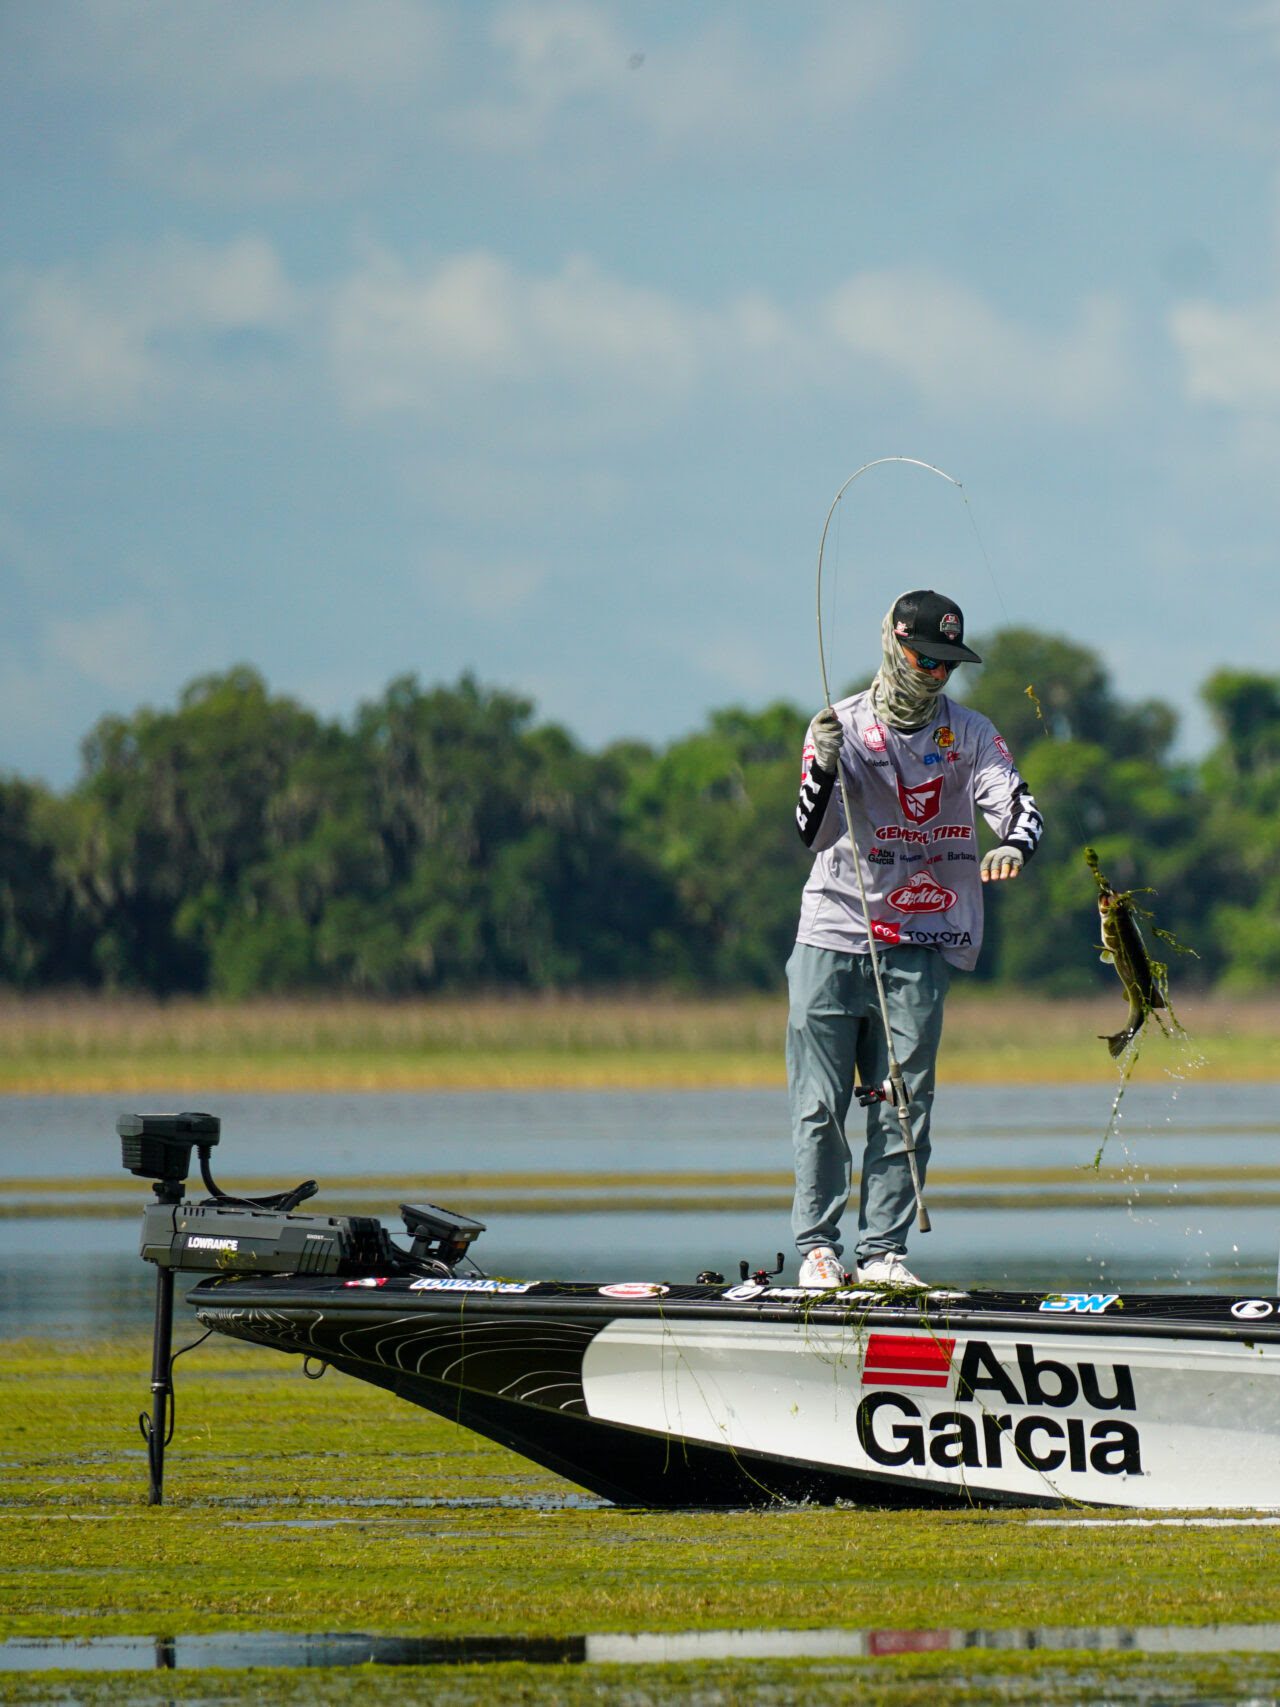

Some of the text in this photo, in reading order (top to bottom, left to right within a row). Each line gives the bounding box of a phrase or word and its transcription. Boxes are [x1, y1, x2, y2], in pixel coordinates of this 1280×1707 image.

[932, 825, 972, 843] TIRE
[868, 853, 895, 865] Garcia
[878, 849, 895, 858] Abu
[904, 930, 972, 946] TOYOTA
[187, 1236, 239, 1251] LOWRANCE
[416, 1278, 528, 1291] LOWRANCE
[955, 1340, 1137, 1411] Abu
[856, 1391, 1145, 1476] Garcia
